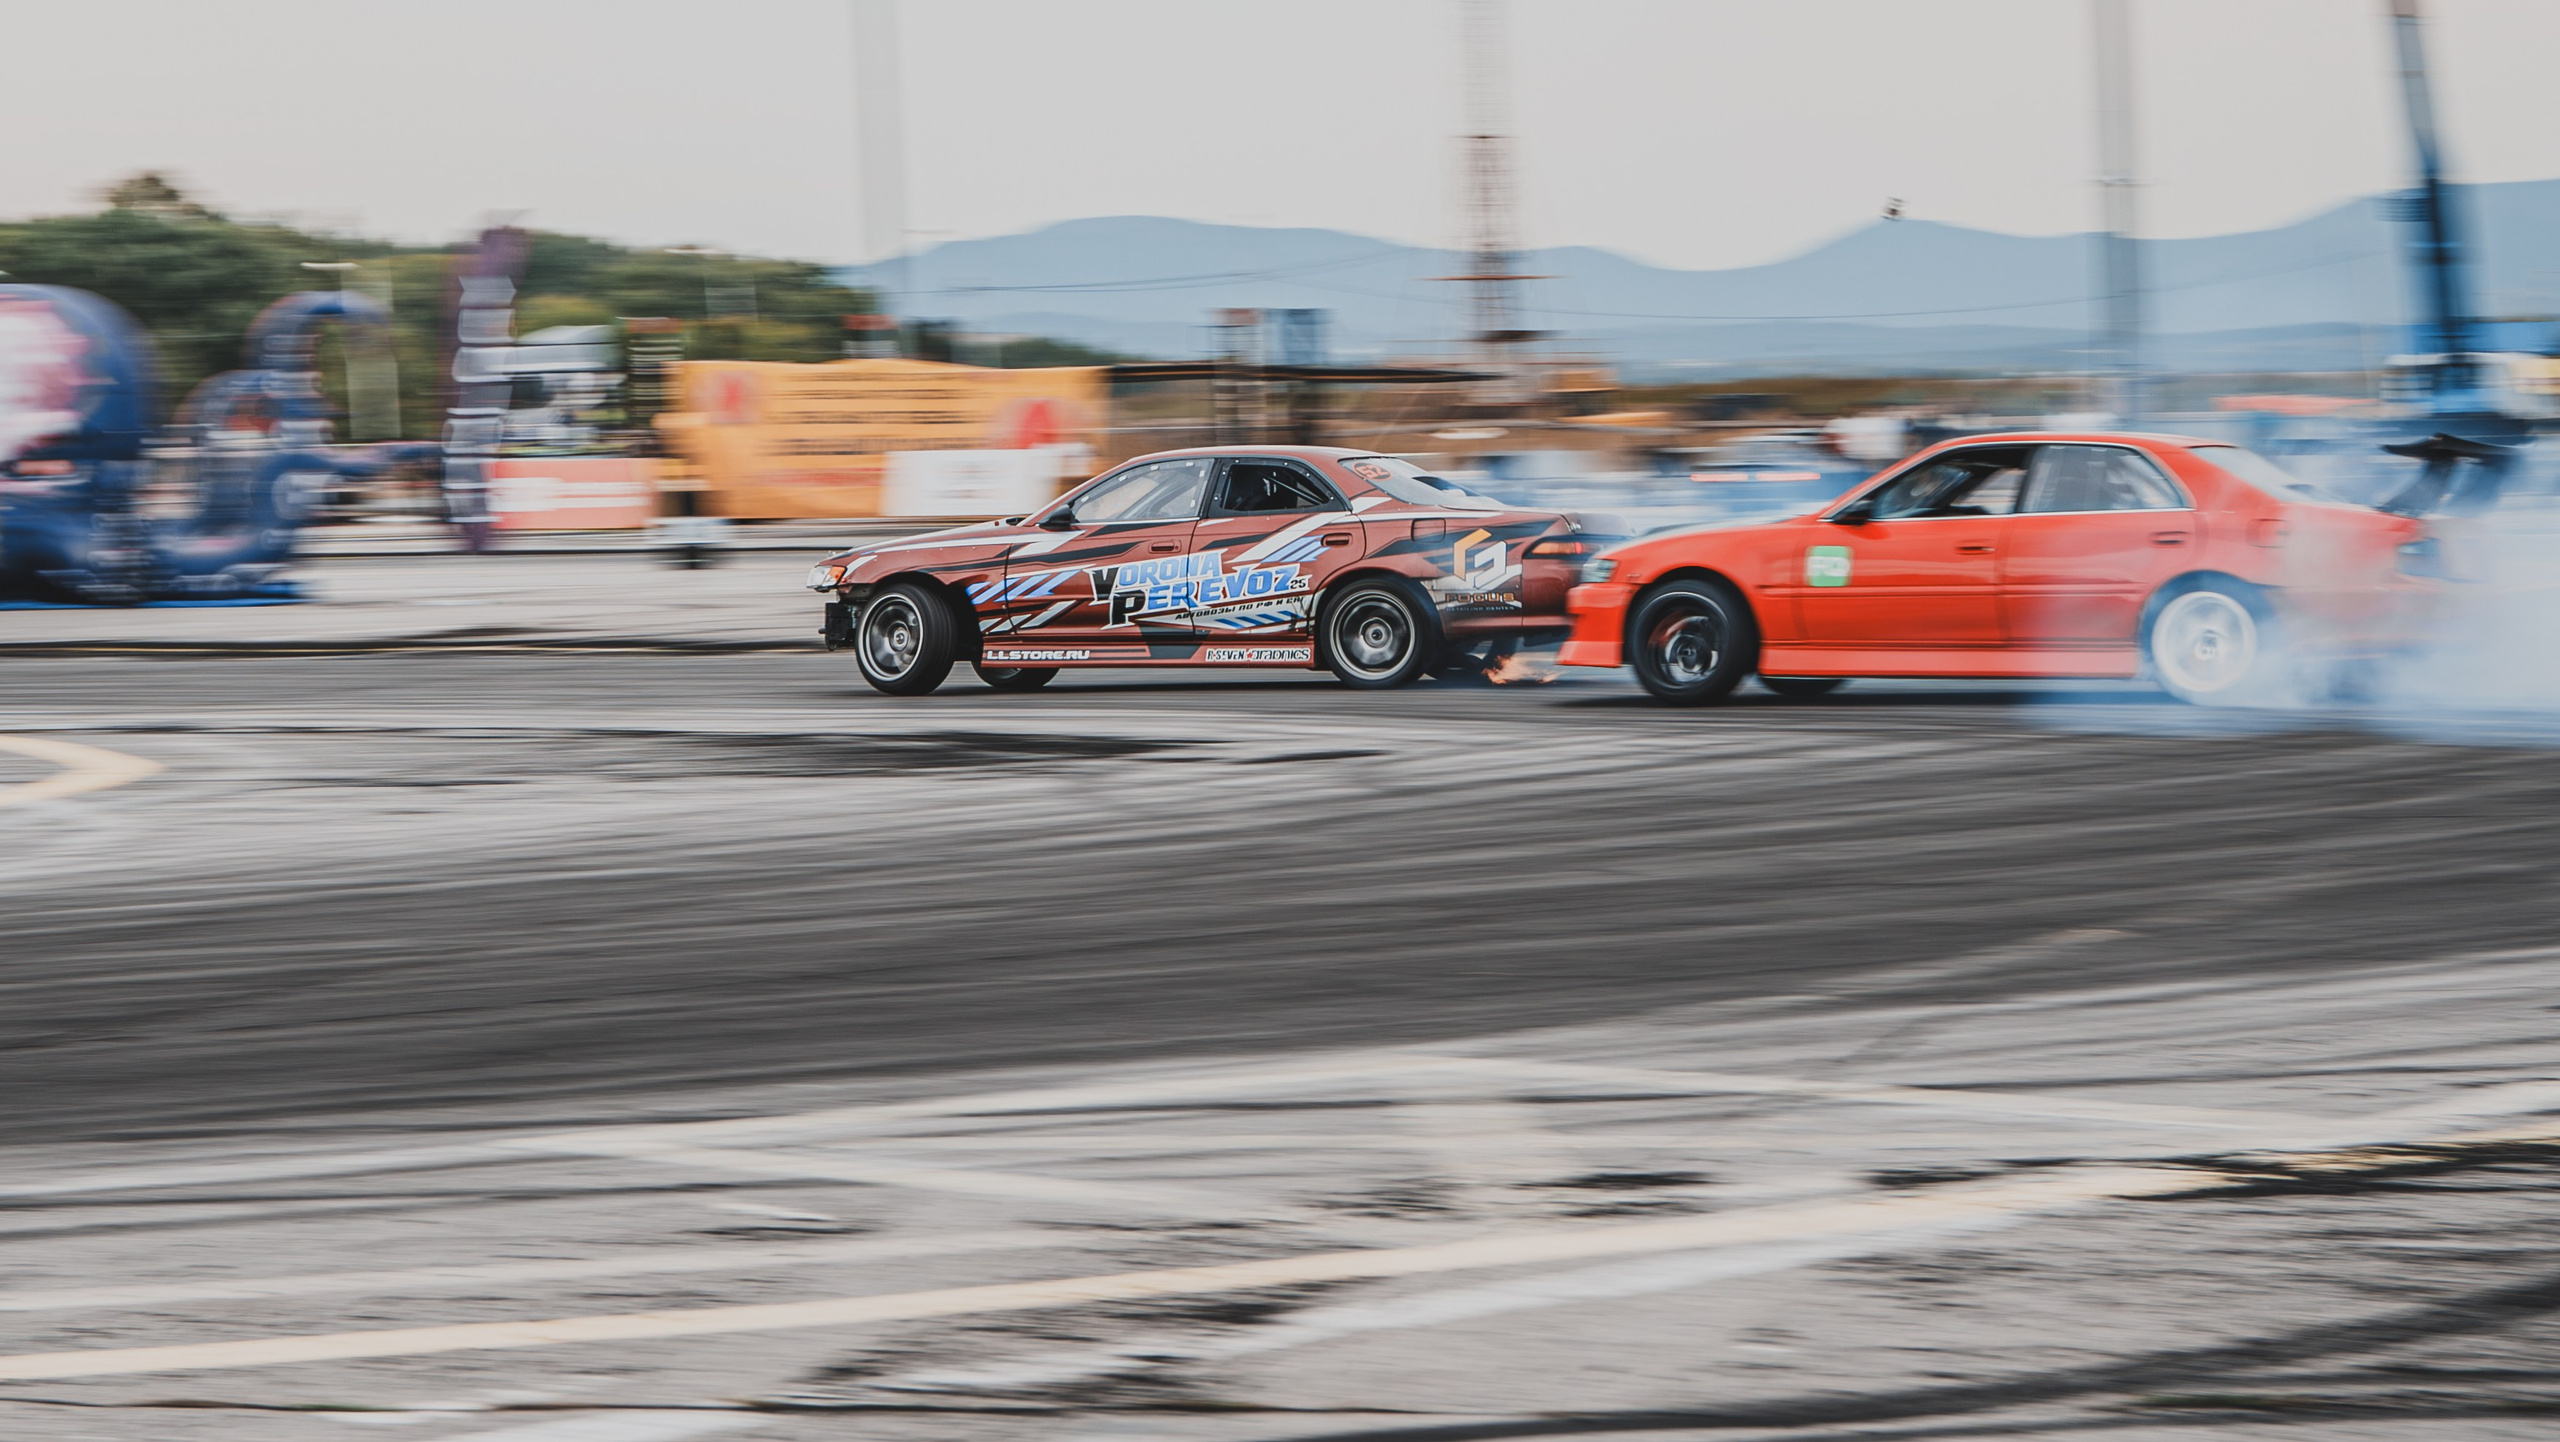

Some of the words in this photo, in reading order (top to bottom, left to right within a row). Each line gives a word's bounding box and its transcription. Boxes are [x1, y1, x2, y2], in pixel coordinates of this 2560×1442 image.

[1090, 551, 1221, 602] VORONA
[1108, 564, 1298, 628] PEREVOZ
[1290, 577, 1306, 590] 25
[1445, 592, 1515, 602] FOCUS
[1174, 605, 1236, 620] АВТОВОЗЫ
[1256, 601, 1273, 609] РФ
[986, 650, 1090, 660] LLSTORE.RU
